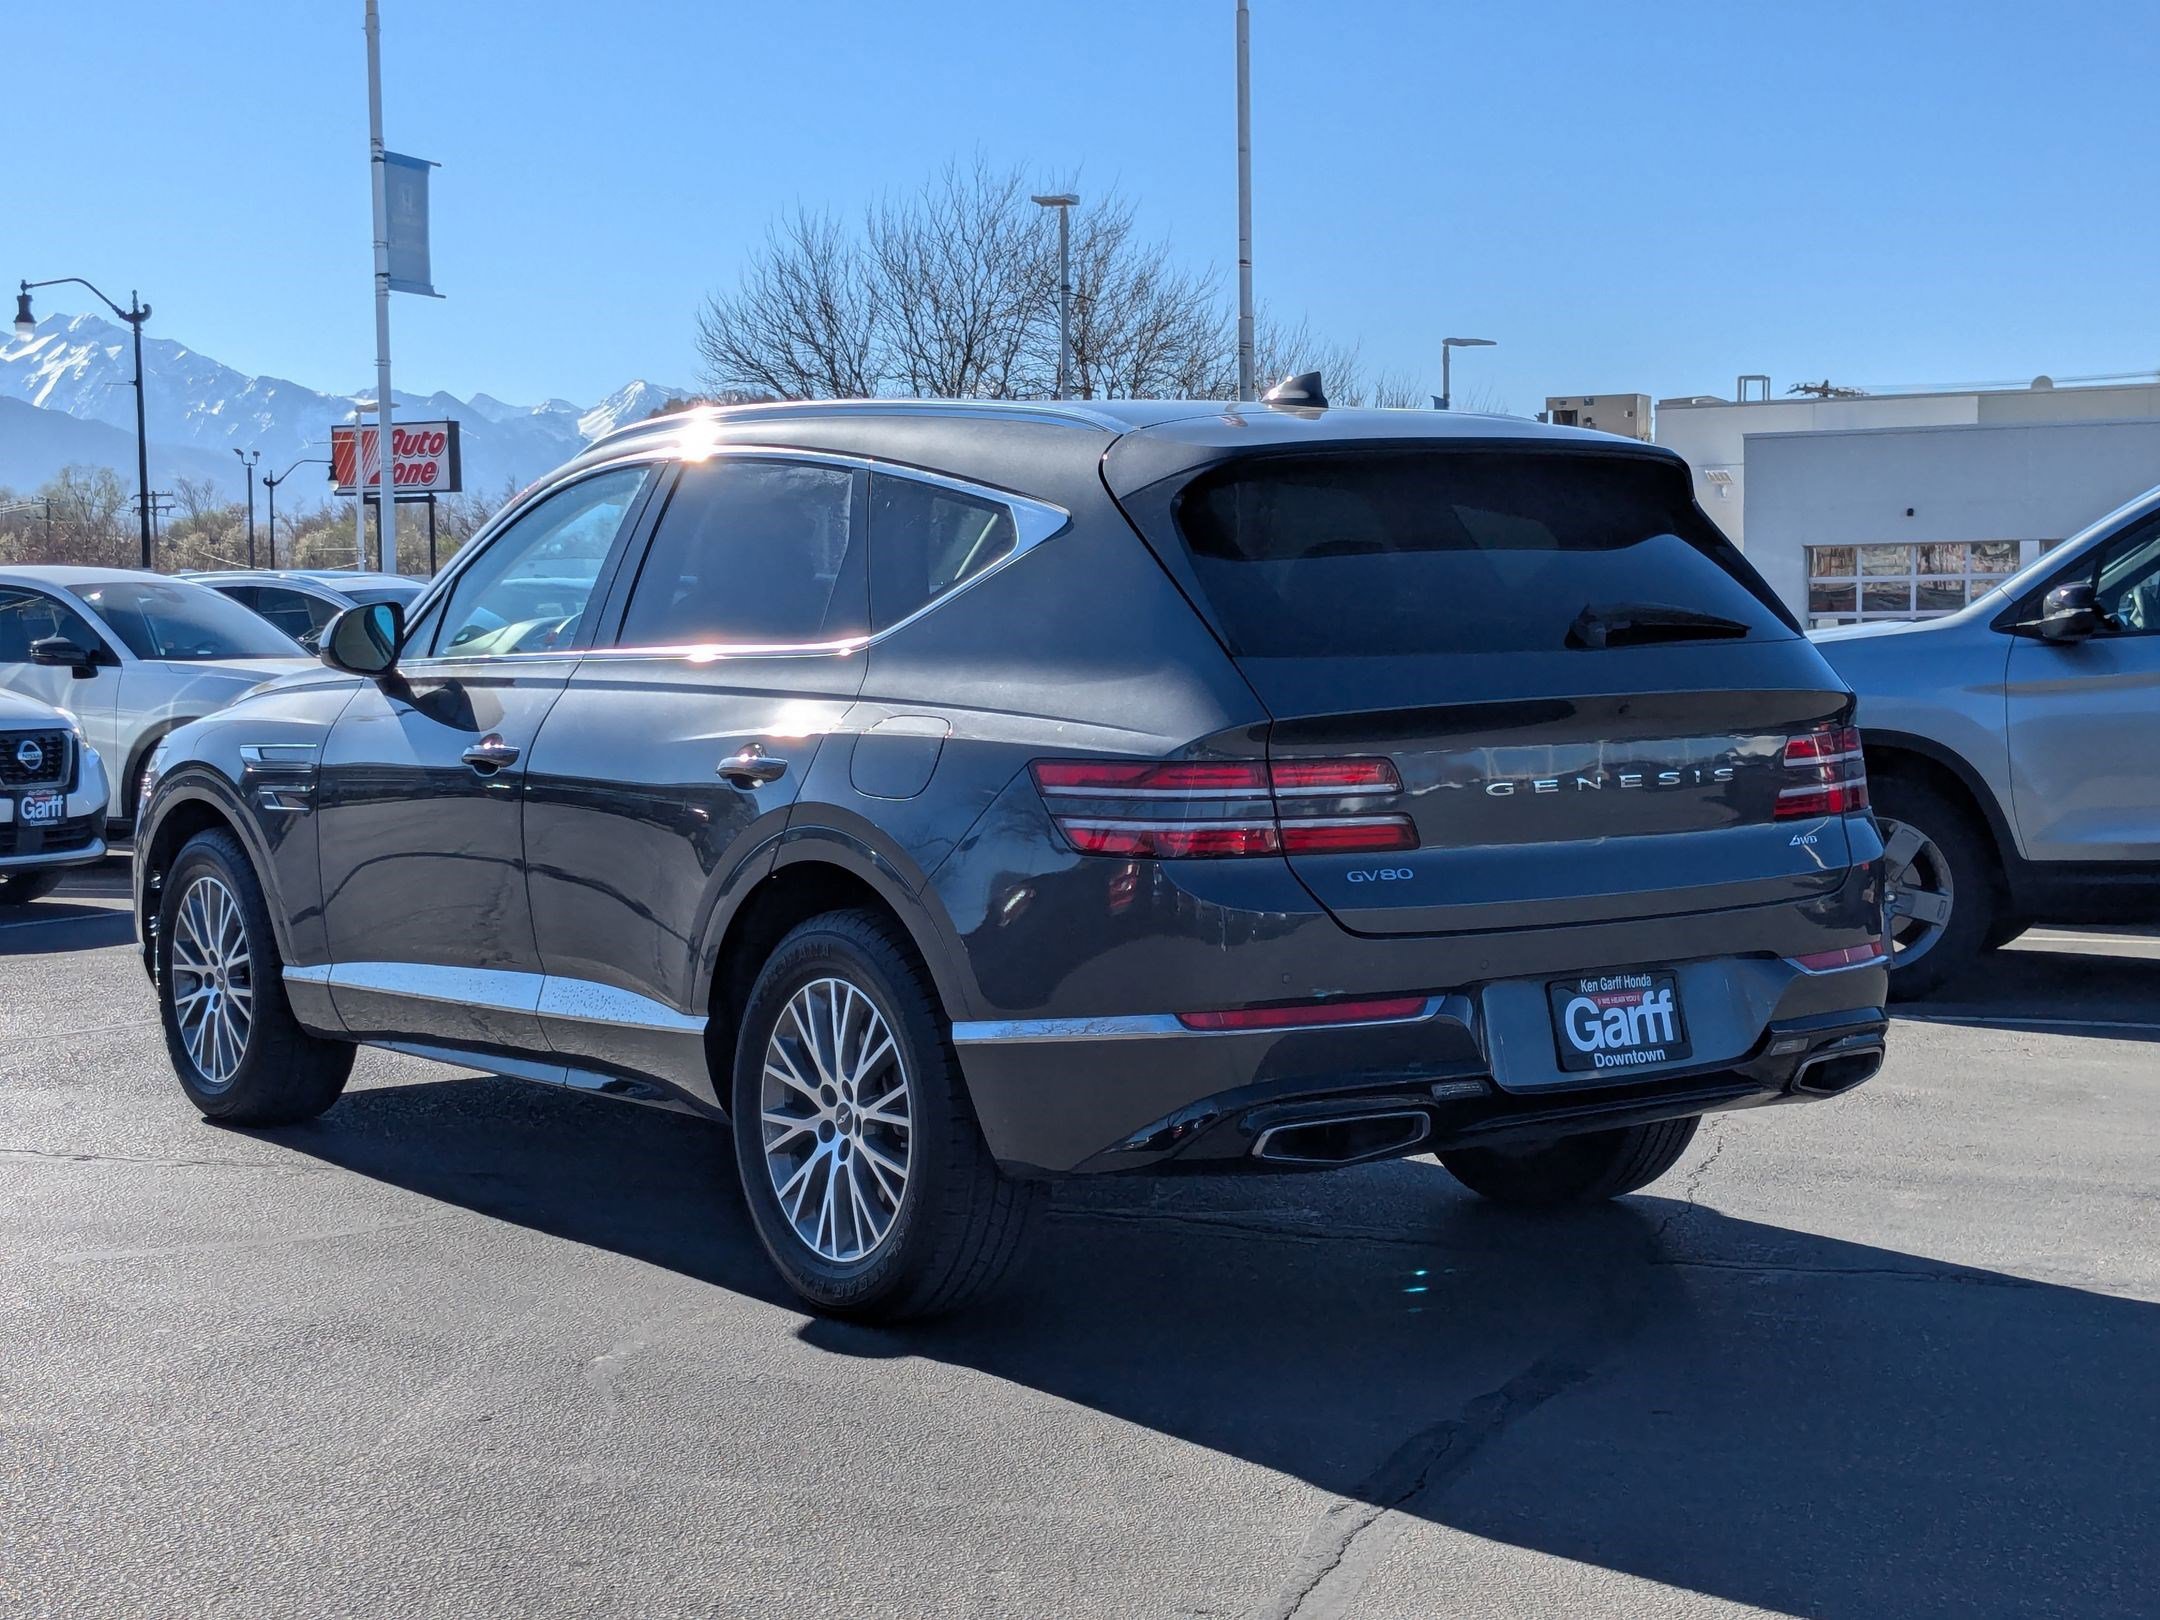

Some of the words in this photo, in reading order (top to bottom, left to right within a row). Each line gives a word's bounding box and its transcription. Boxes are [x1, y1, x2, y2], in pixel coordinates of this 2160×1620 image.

[392, 429, 447, 458] Auto
[1485, 768, 1734, 796] GENESIS
[21, 795, 63, 820] Garff
[1346, 868, 1414, 882] GV80
[1580, 978, 1598, 993] Ken
[1600, 975, 1622, 991] Garff
[1623, 973, 1652, 988] Honda
[1564, 988, 1674, 1052] Garff
[1594, 1049, 1666, 1068] Downtown
